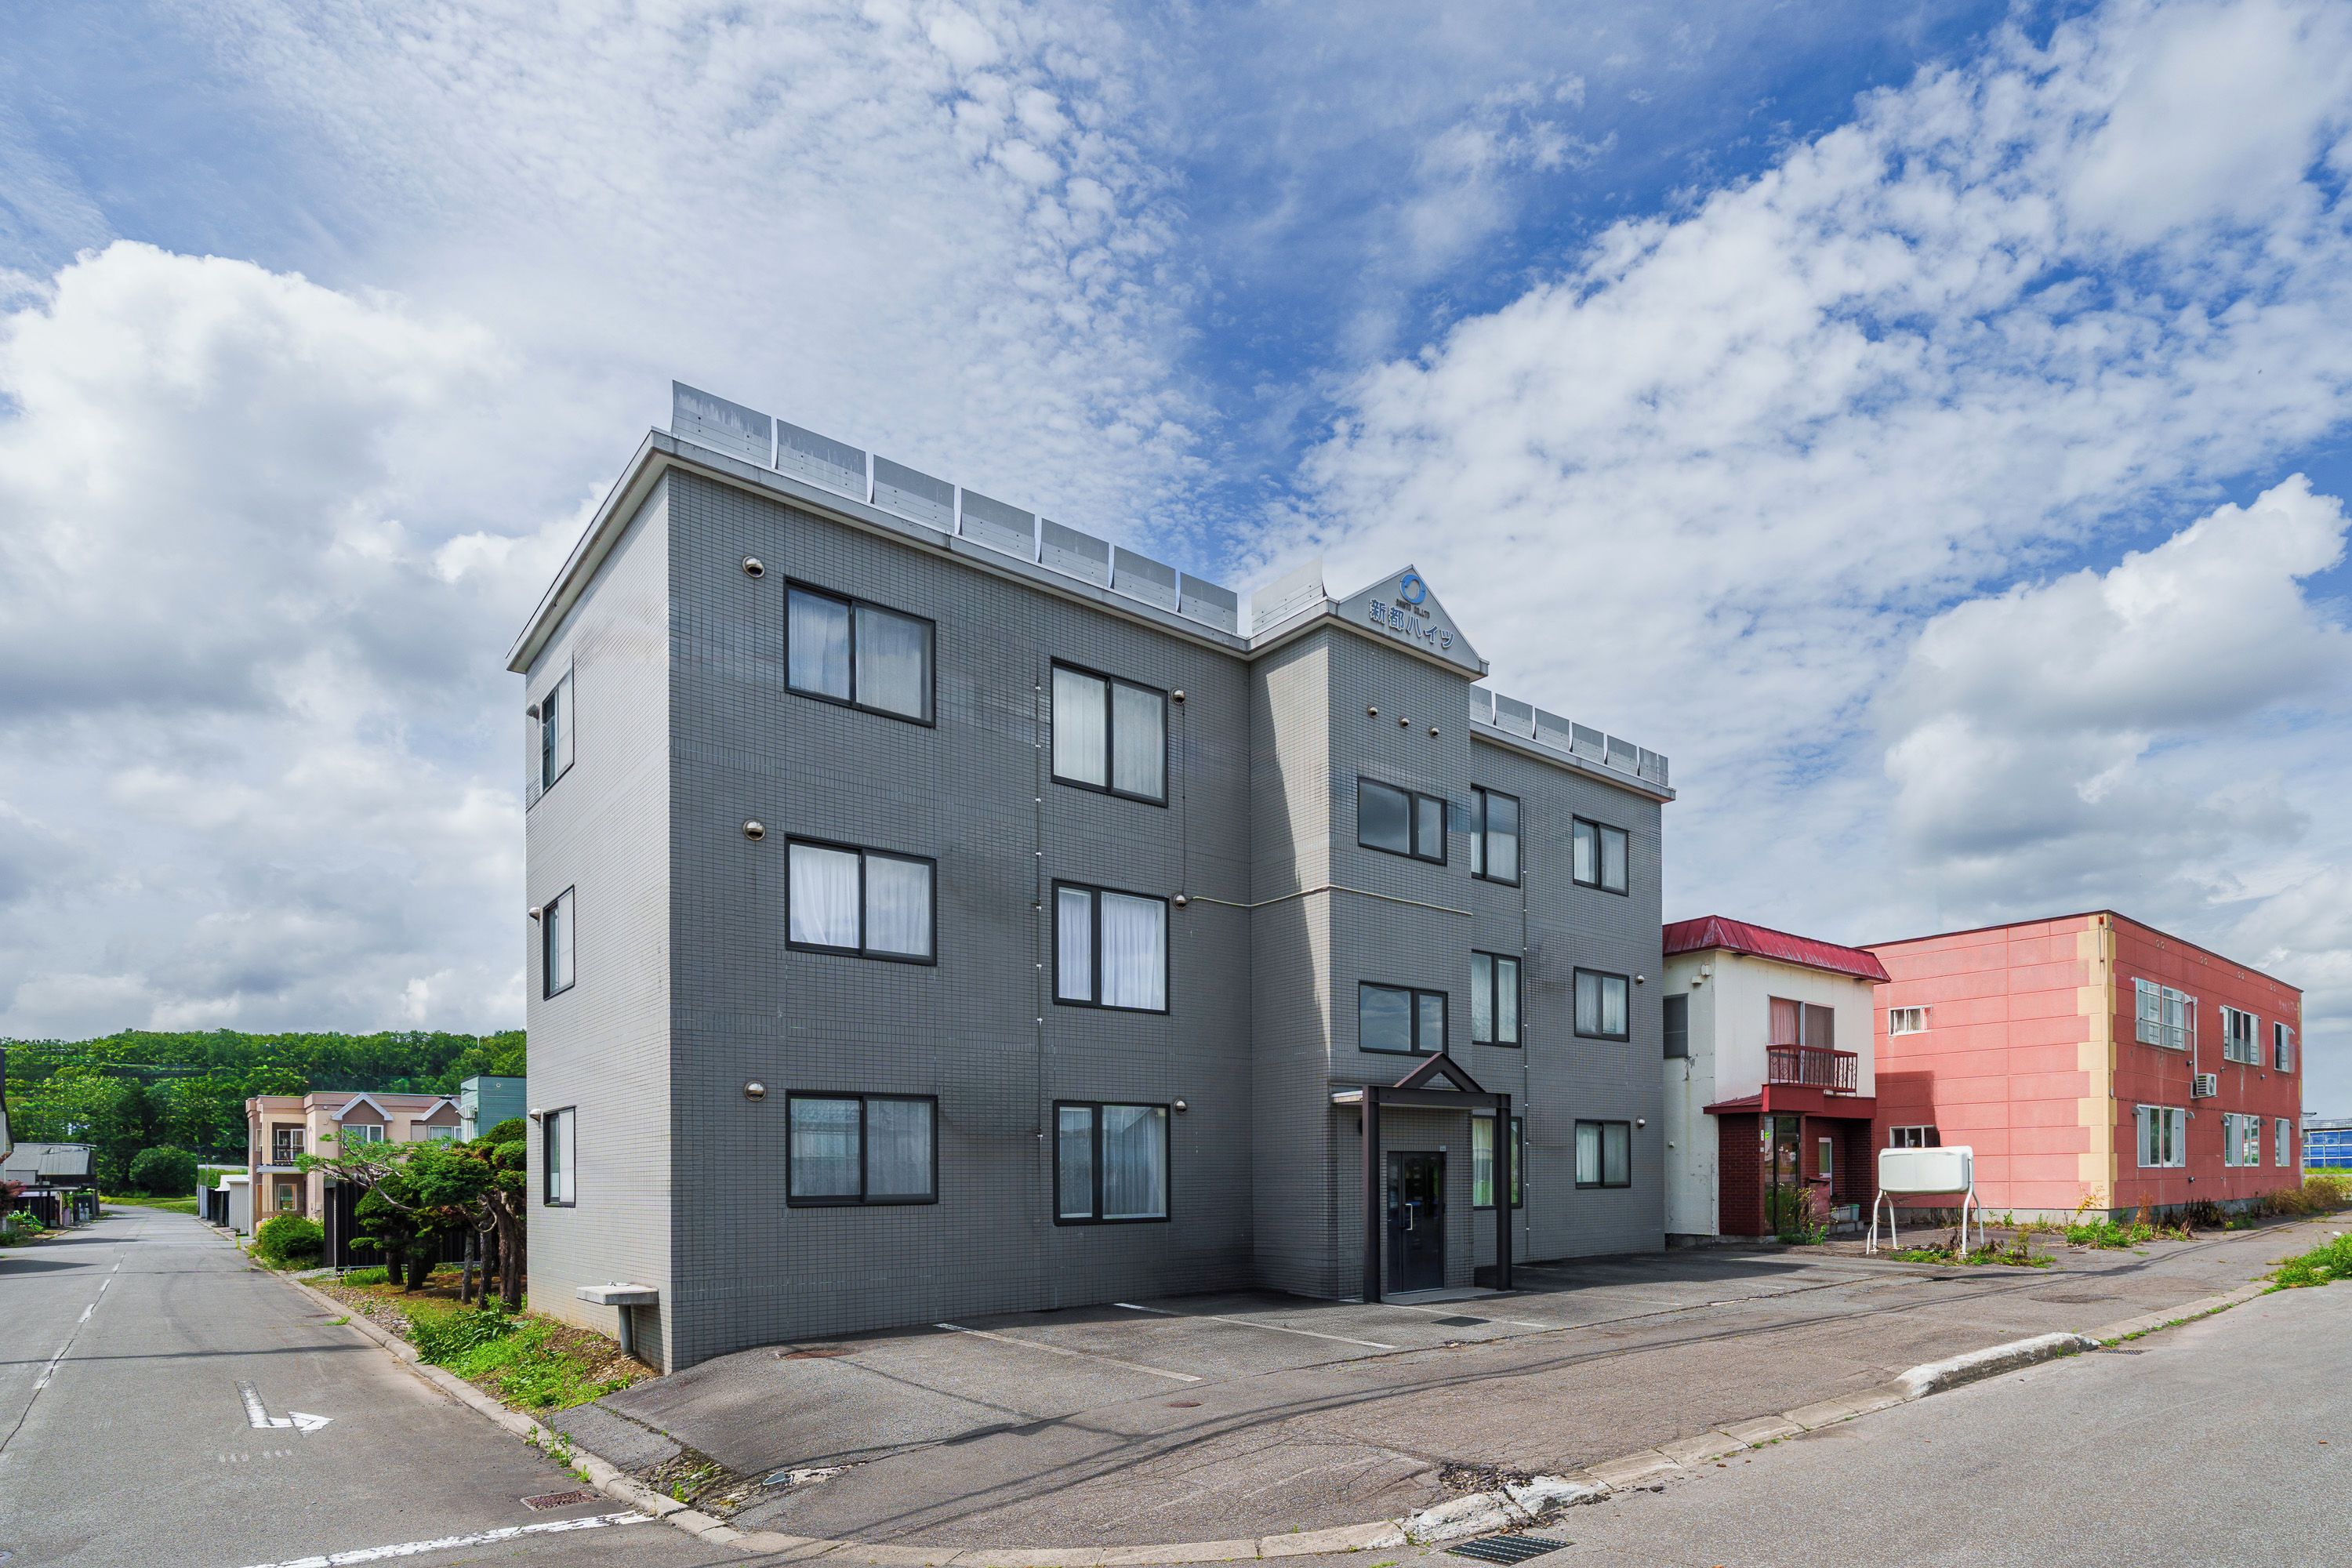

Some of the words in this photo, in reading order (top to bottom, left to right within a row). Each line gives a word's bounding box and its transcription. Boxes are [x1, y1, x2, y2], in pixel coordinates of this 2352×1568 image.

[1369, 598, 1454, 648] 新都ハイツ
